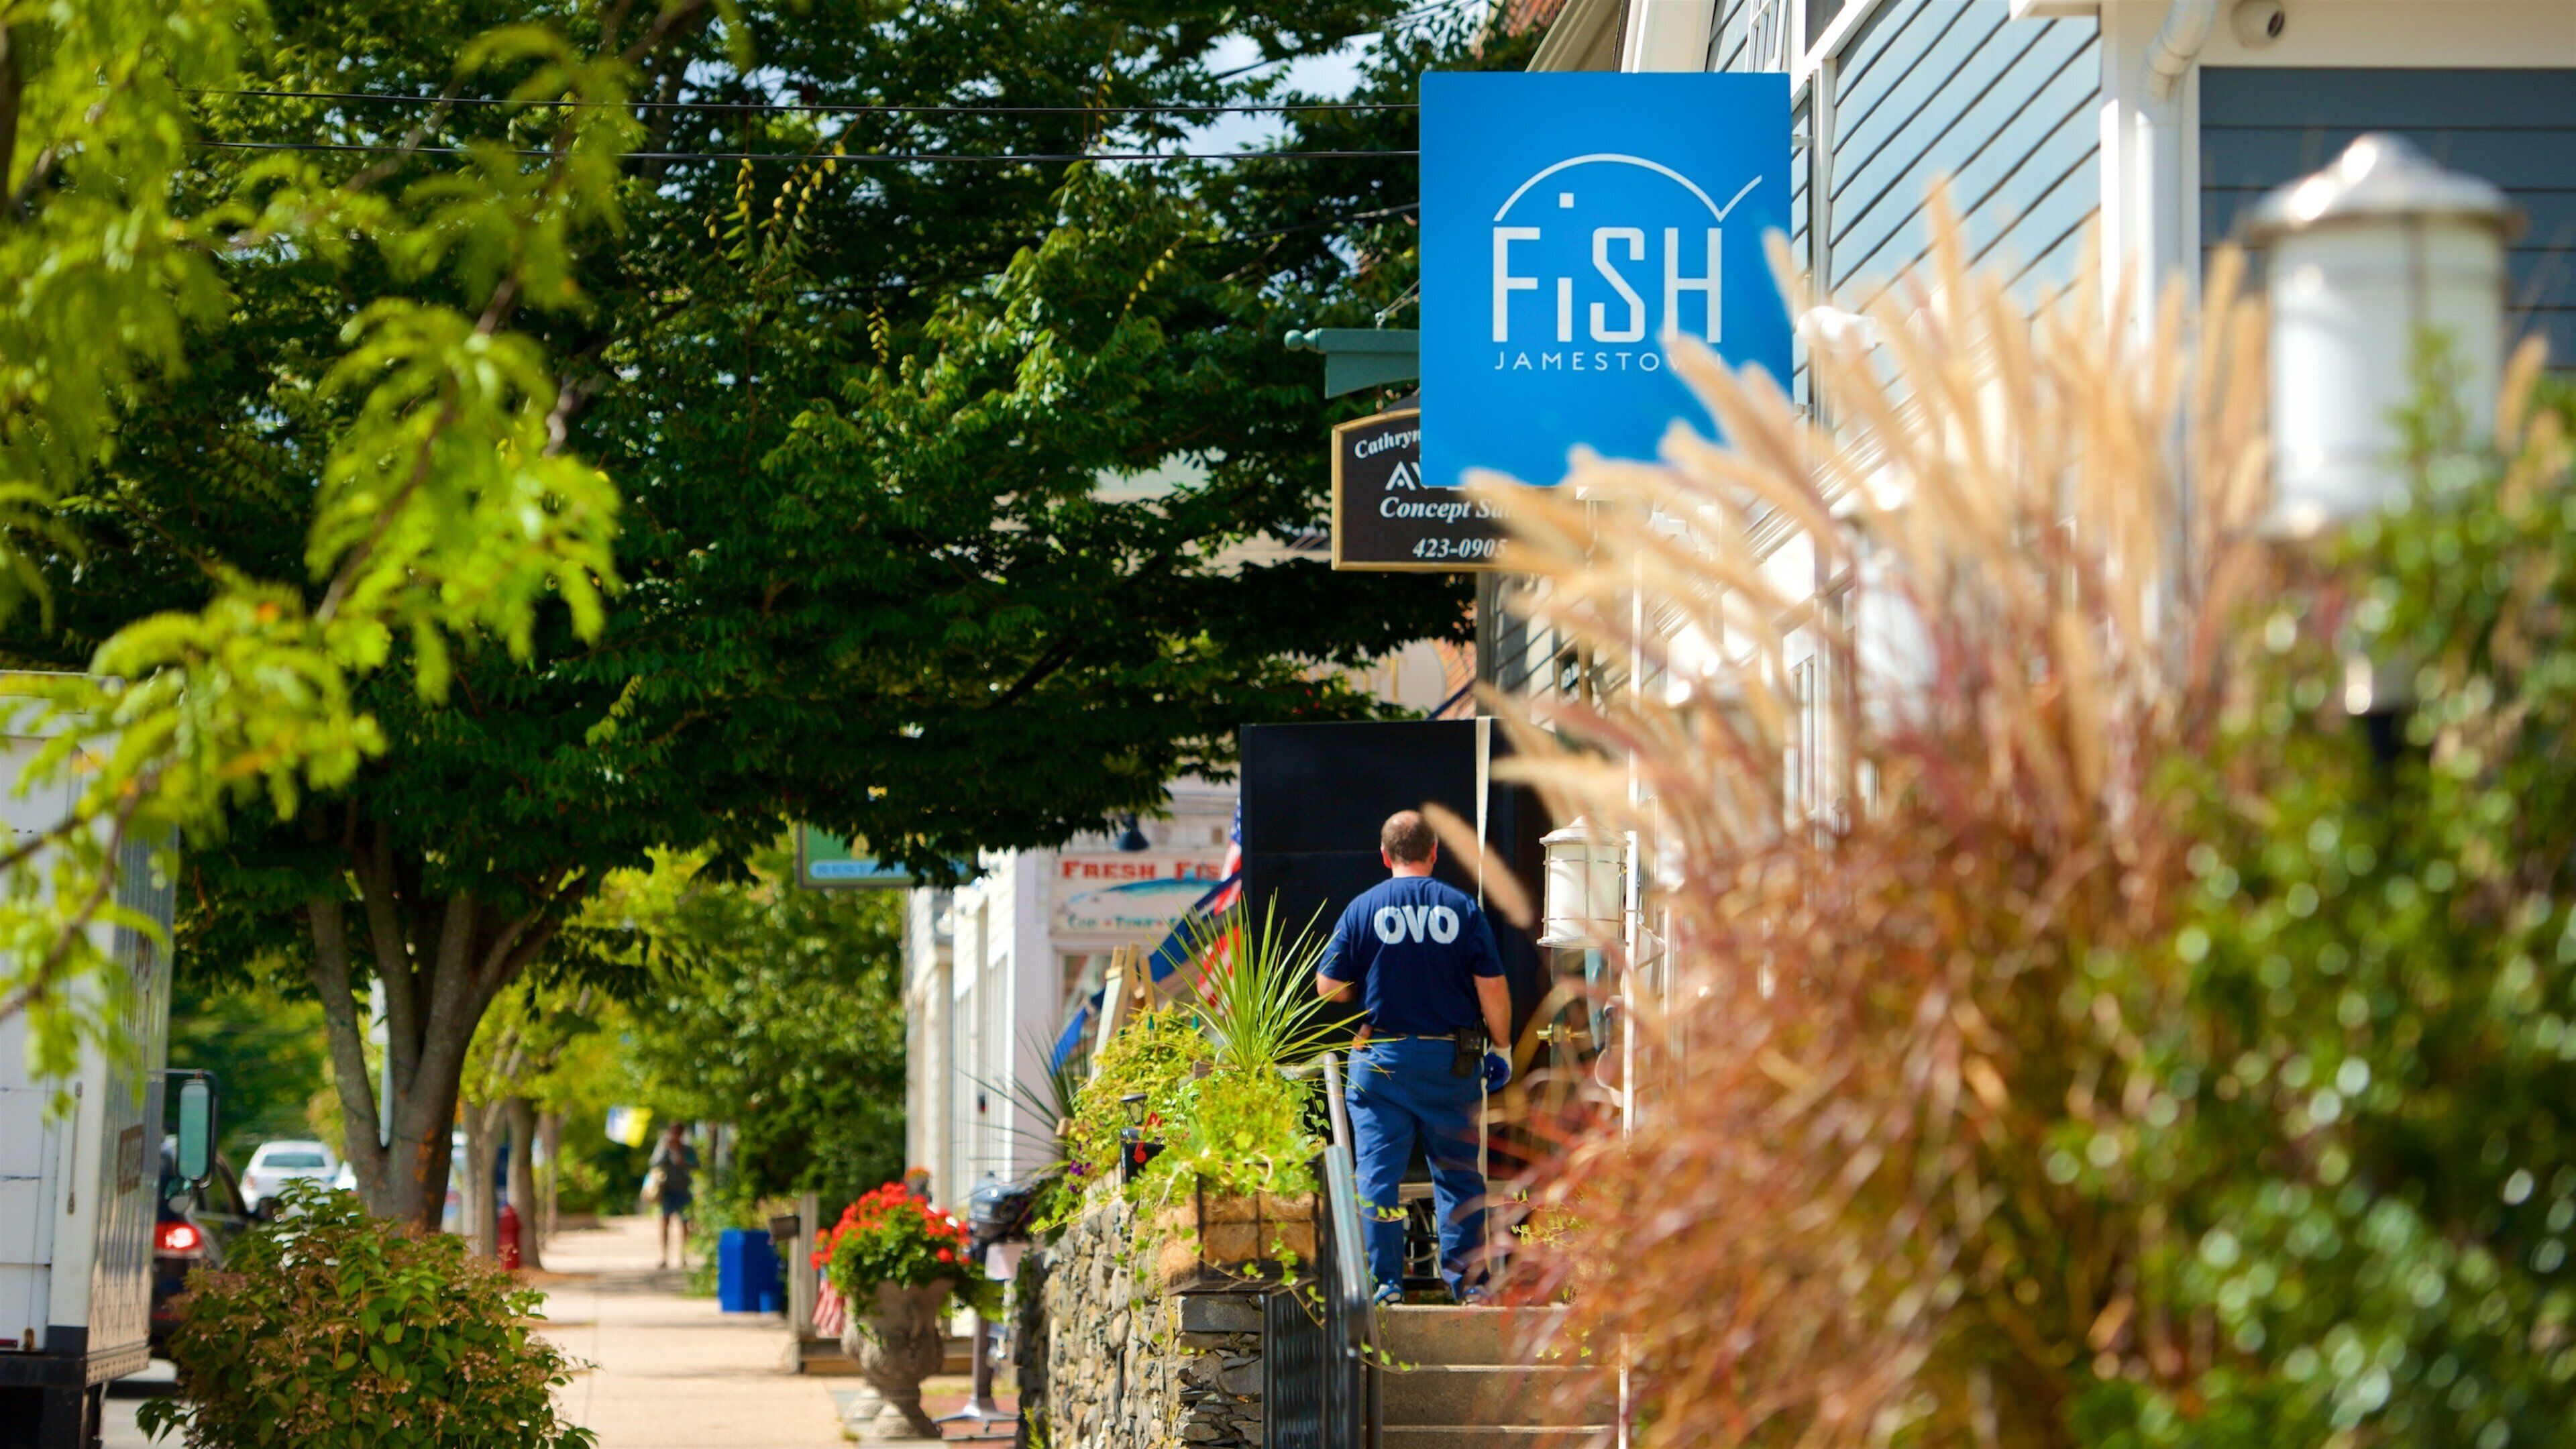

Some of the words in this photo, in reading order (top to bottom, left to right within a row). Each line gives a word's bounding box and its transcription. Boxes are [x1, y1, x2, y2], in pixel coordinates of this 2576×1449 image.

[1379, 496, 1471, 523] Concept
[1412, 537, 1508, 558] 423-0905
[1061, 861, 1157, 879] FRESH
[1175, 861, 1220, 881] FIS
[1373, 904, 1460, 945] OVO
